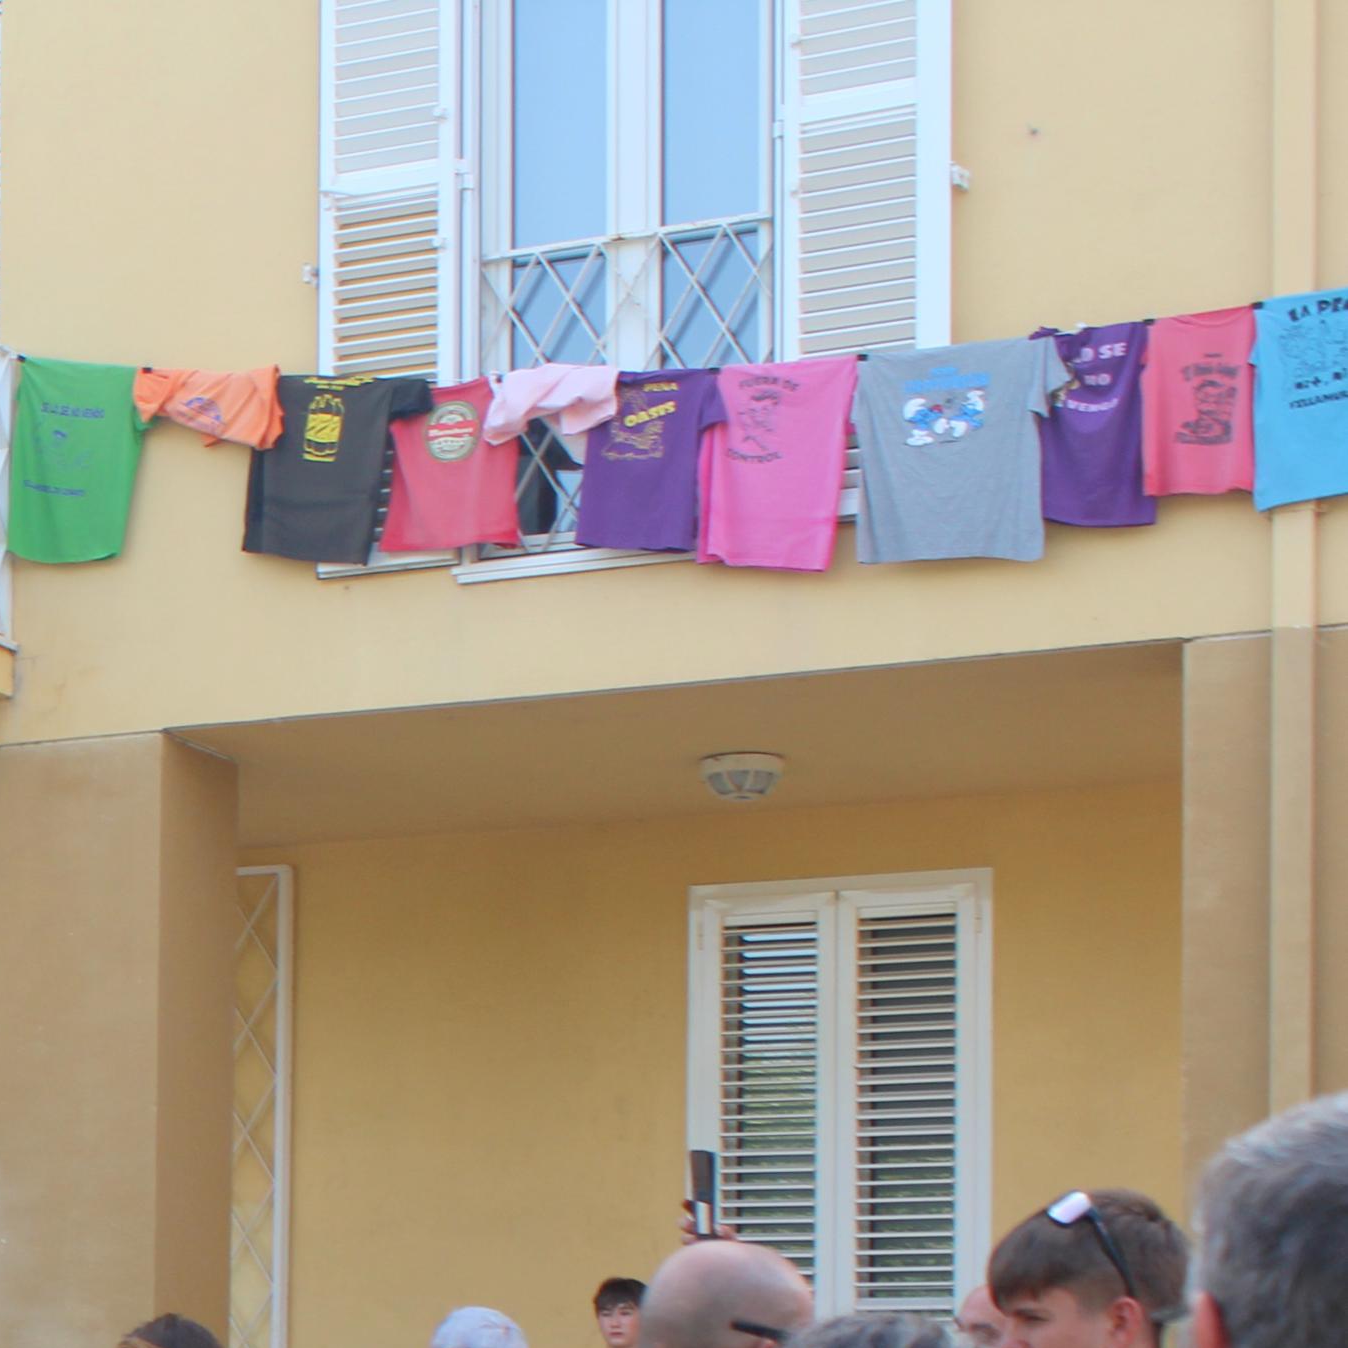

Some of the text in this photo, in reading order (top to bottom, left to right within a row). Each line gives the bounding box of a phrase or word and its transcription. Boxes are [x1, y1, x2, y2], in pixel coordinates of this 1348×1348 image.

[1316, 296, 1348, 314] PE
[1098, 342, 1127, 359] SE
[624, 401, 676, 428] OASIS
[727, 448, 783, 463] CONTROL
